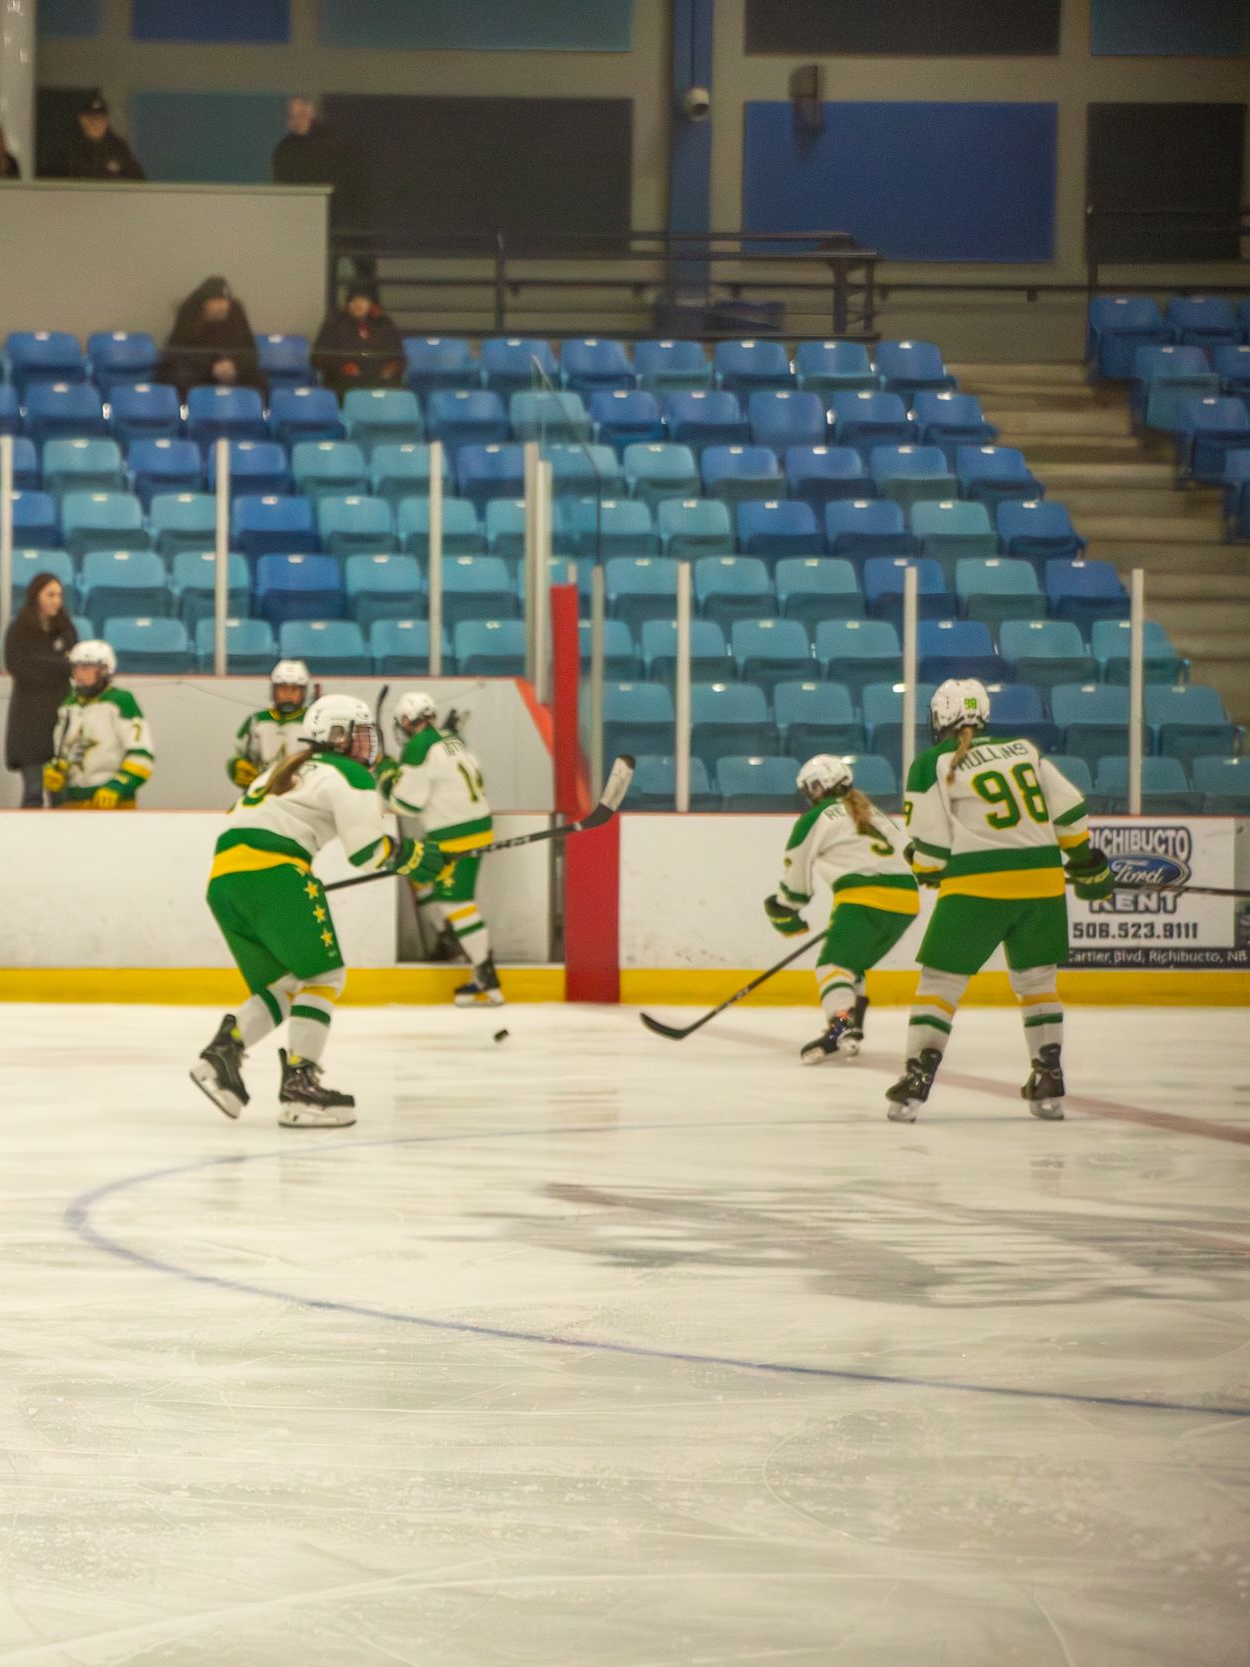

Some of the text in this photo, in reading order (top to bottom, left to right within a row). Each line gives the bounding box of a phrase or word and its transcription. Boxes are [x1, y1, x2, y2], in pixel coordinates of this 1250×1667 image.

[963, 698, 978, 710] 98
[971, 763, 1049, 830] 98
[1111, 859, 1163, 883] Ford
[1073, 922, 1199, 939] 506.523.9111
